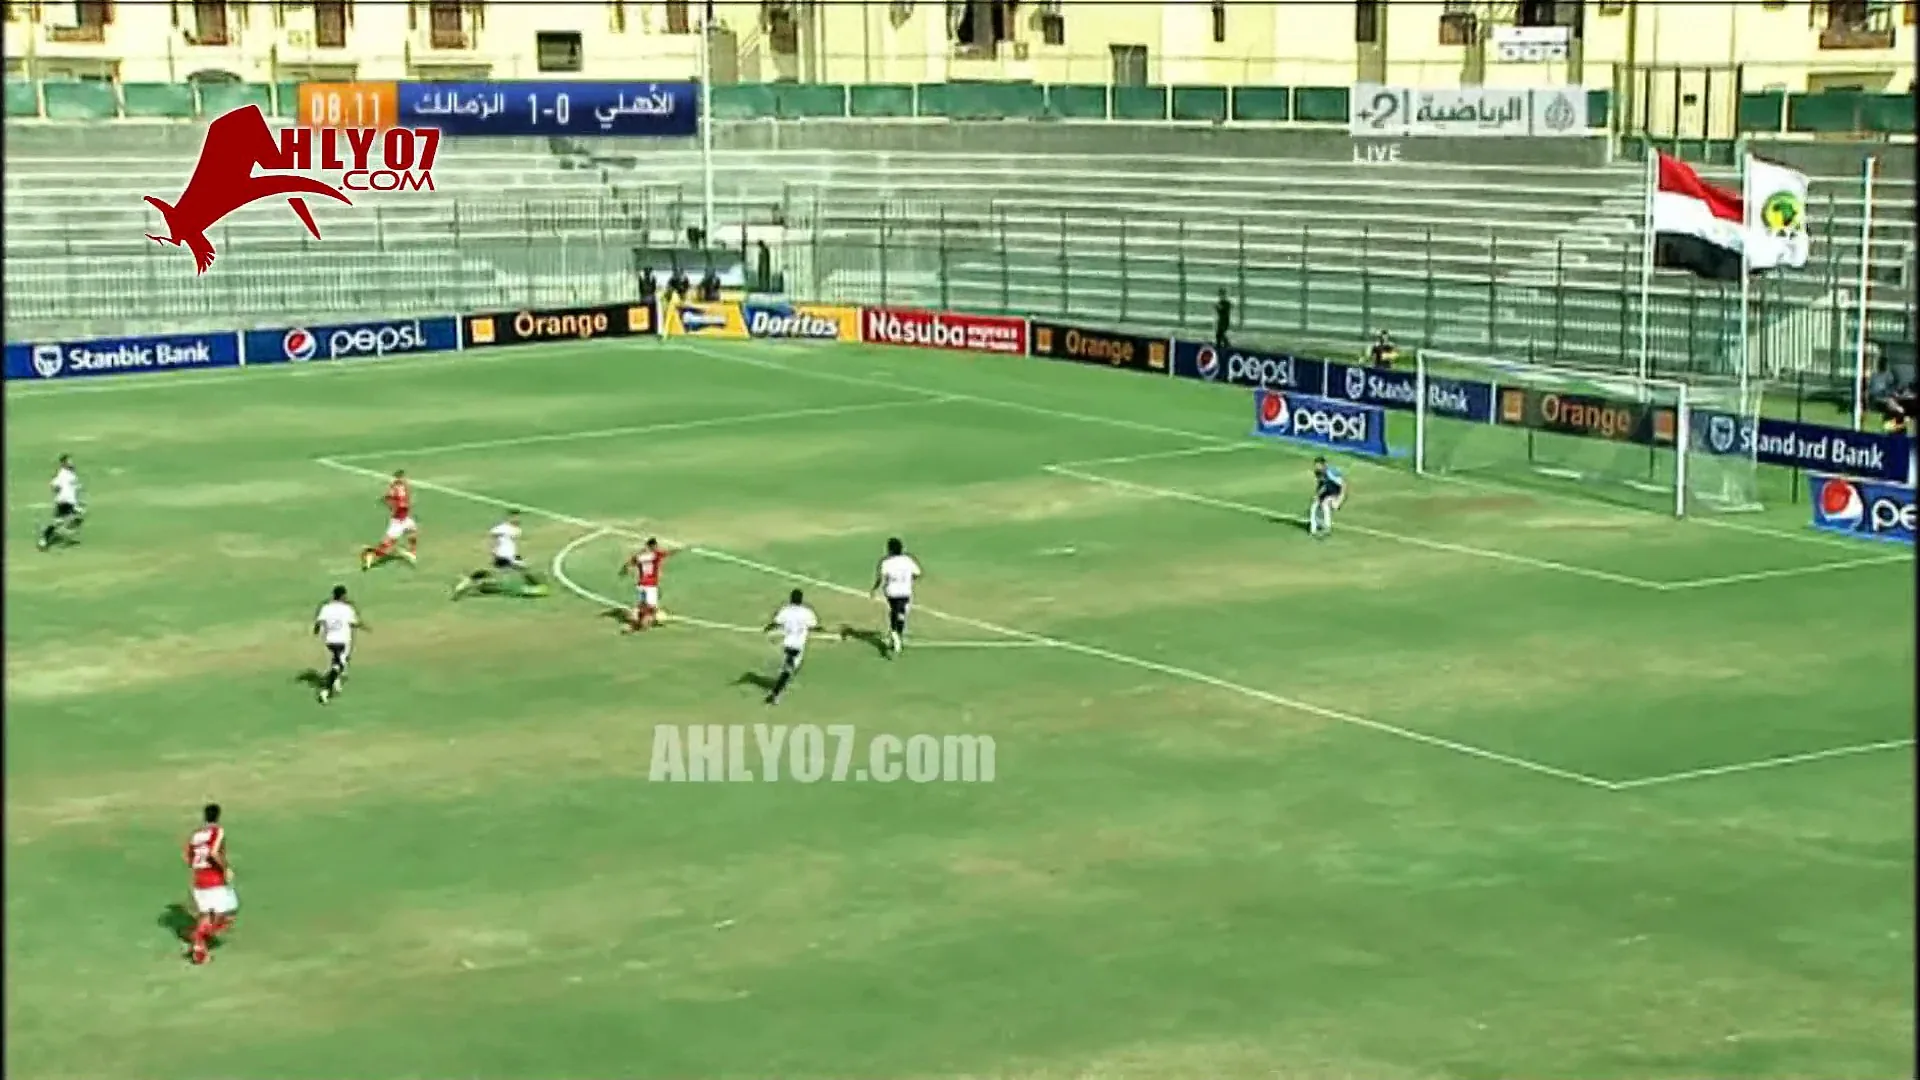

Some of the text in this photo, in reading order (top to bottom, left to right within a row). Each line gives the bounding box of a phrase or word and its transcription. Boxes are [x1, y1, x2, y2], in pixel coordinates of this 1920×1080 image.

[514, 311, 609, 338] Orange
[751, 310, 838, 340] Doritos
[69, 341, 210, 373] Stanbic Bank
[1065, 331, 1134, 363] Orange
[1368, 375, 1427, 402] Stanb
[1541, 393, 1632, 437] Orange
[1739, 425, 1884, 469] Sandrd Bank
